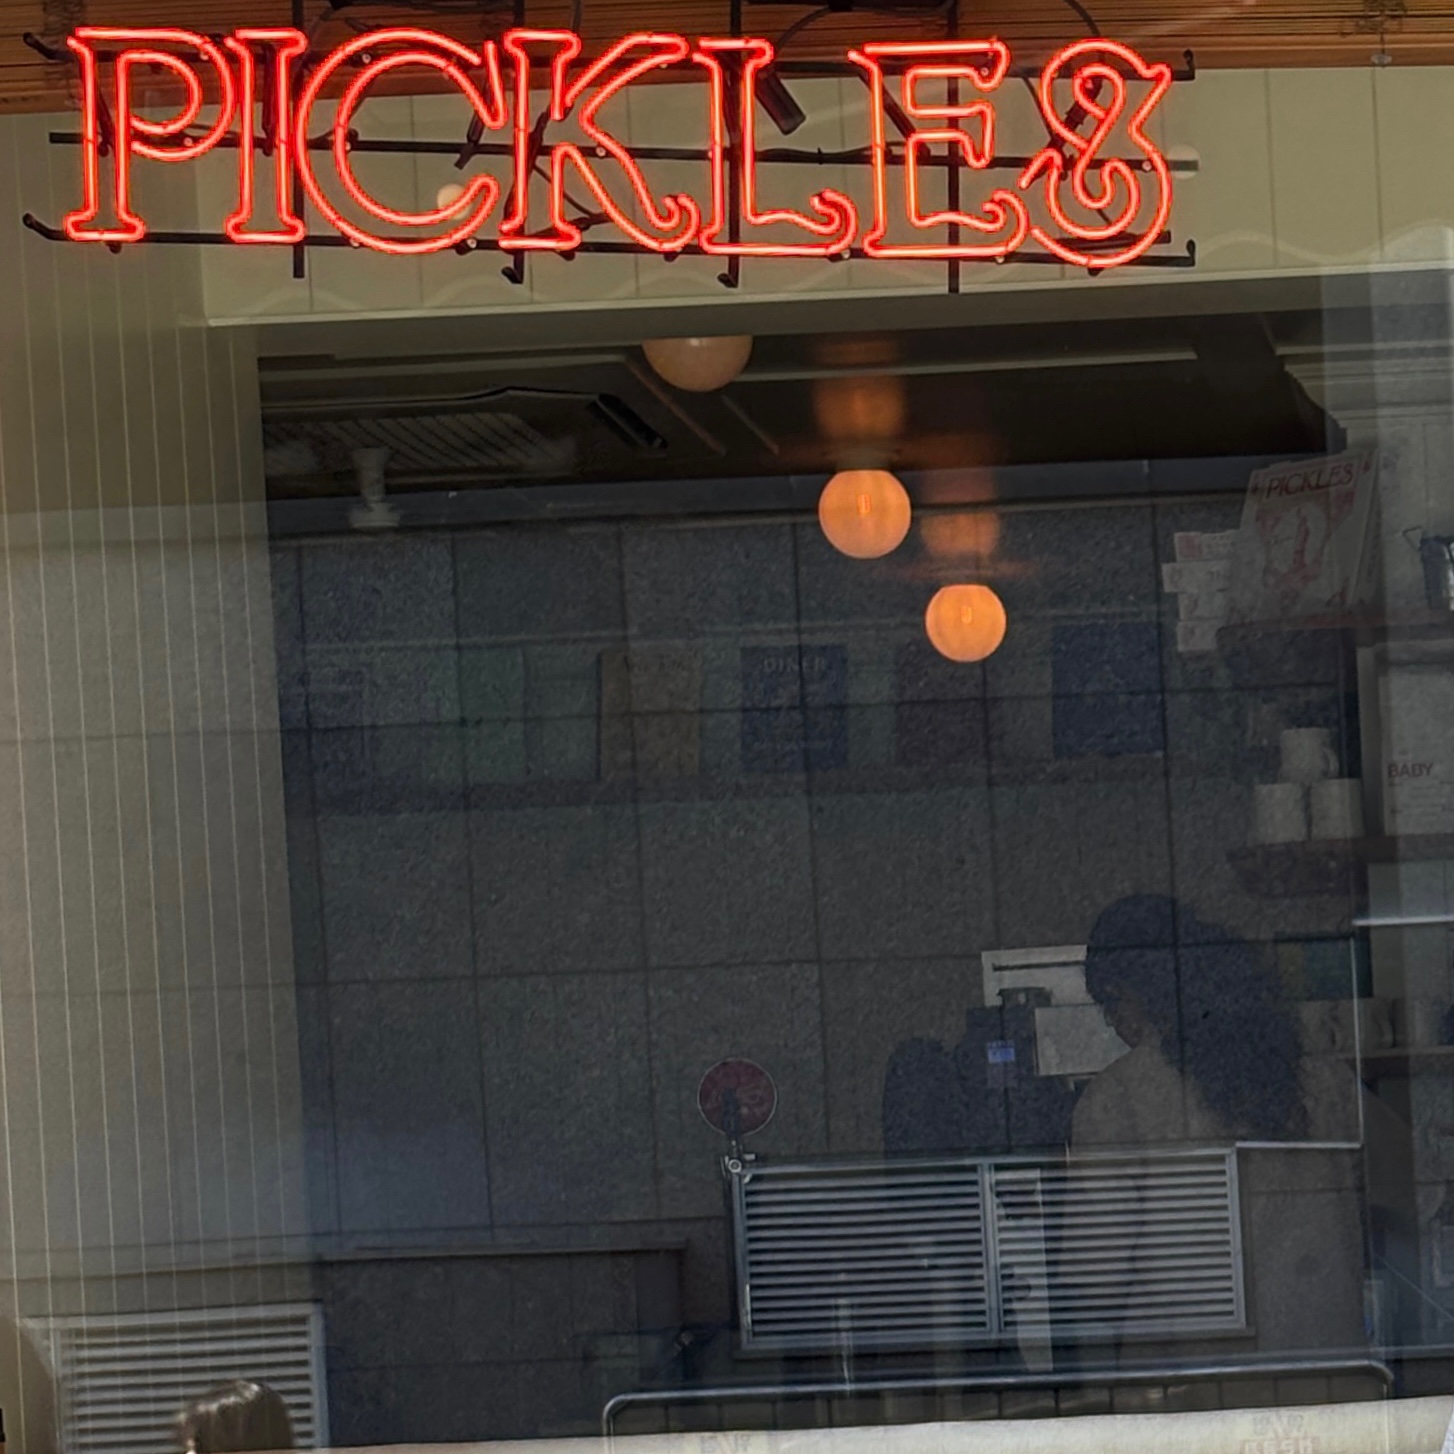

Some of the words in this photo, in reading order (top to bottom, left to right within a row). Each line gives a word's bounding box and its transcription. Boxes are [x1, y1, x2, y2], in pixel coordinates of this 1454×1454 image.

[65, 27, 1171, 268] PICKLES
[1267, 464, 1354, 498] PICKLES
[1386, 761, 1434, 779] BABY
